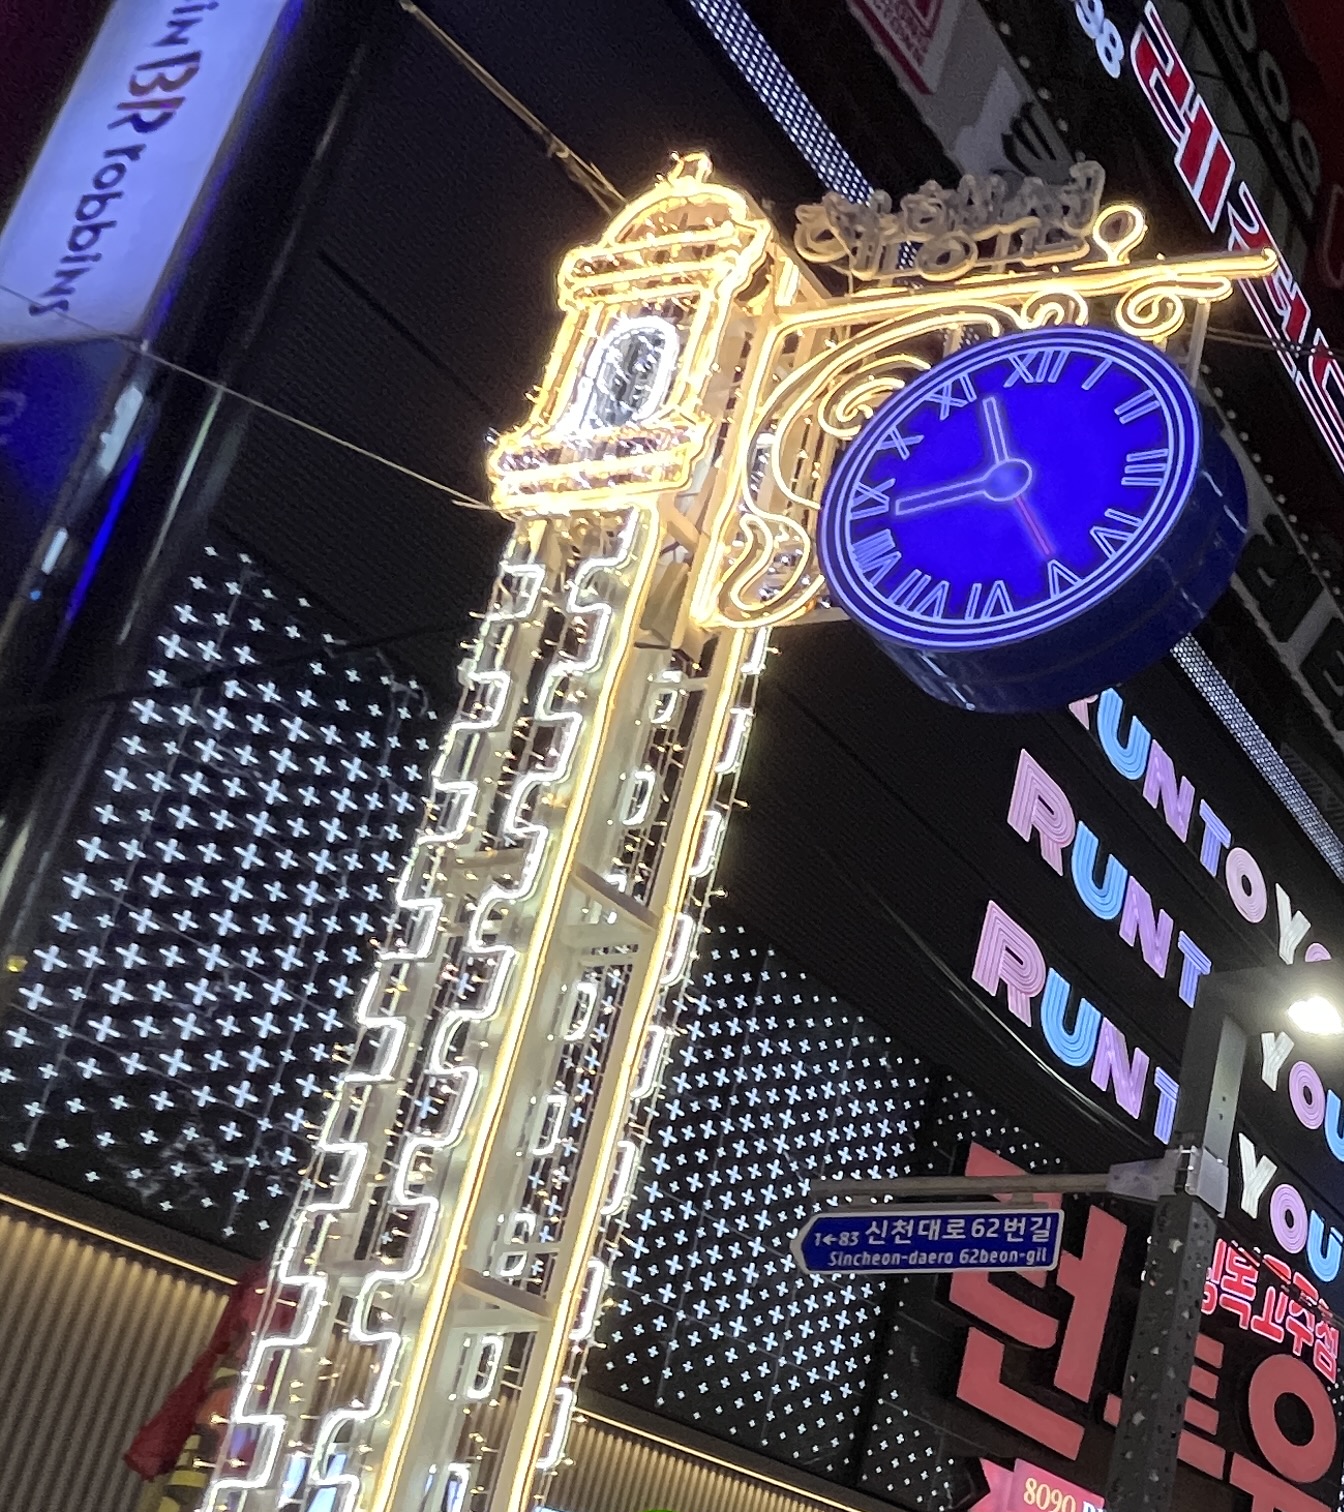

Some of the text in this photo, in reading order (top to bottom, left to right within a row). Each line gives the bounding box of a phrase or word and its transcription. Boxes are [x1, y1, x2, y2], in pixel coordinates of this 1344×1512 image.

[29, 143, 146, 317] robbins
[865, 1216, 1052, 1244] 신천대로62번길
[1238, 1133, 1344, 1282] YOU
[828, 1247, 1048, 1268] Sincheon-daero 62beon-gil
